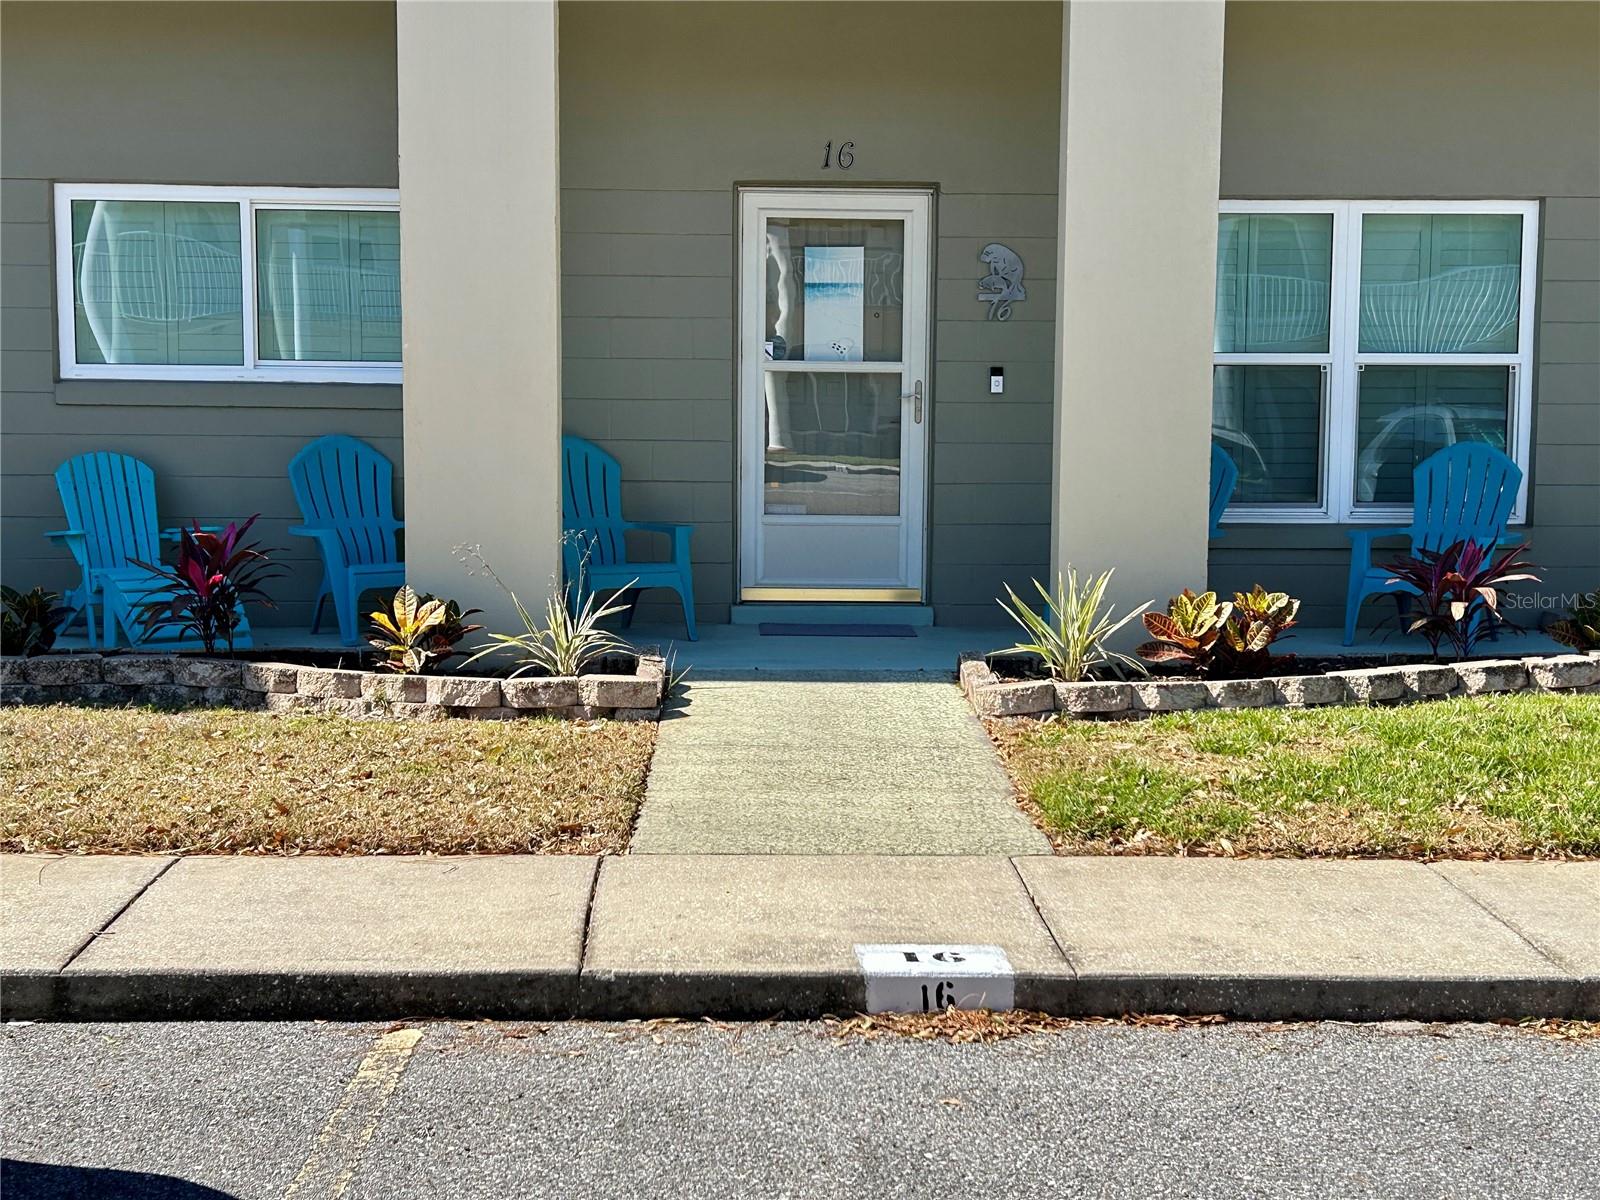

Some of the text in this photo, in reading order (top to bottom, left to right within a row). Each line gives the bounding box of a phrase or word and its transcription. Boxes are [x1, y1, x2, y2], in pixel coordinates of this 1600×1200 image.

[822, 140, 855, 170] 16
[988, 300, 1011, 321] 16
[903, 952, 966, 963] 16
[921, 981, 956, 1013] 16
